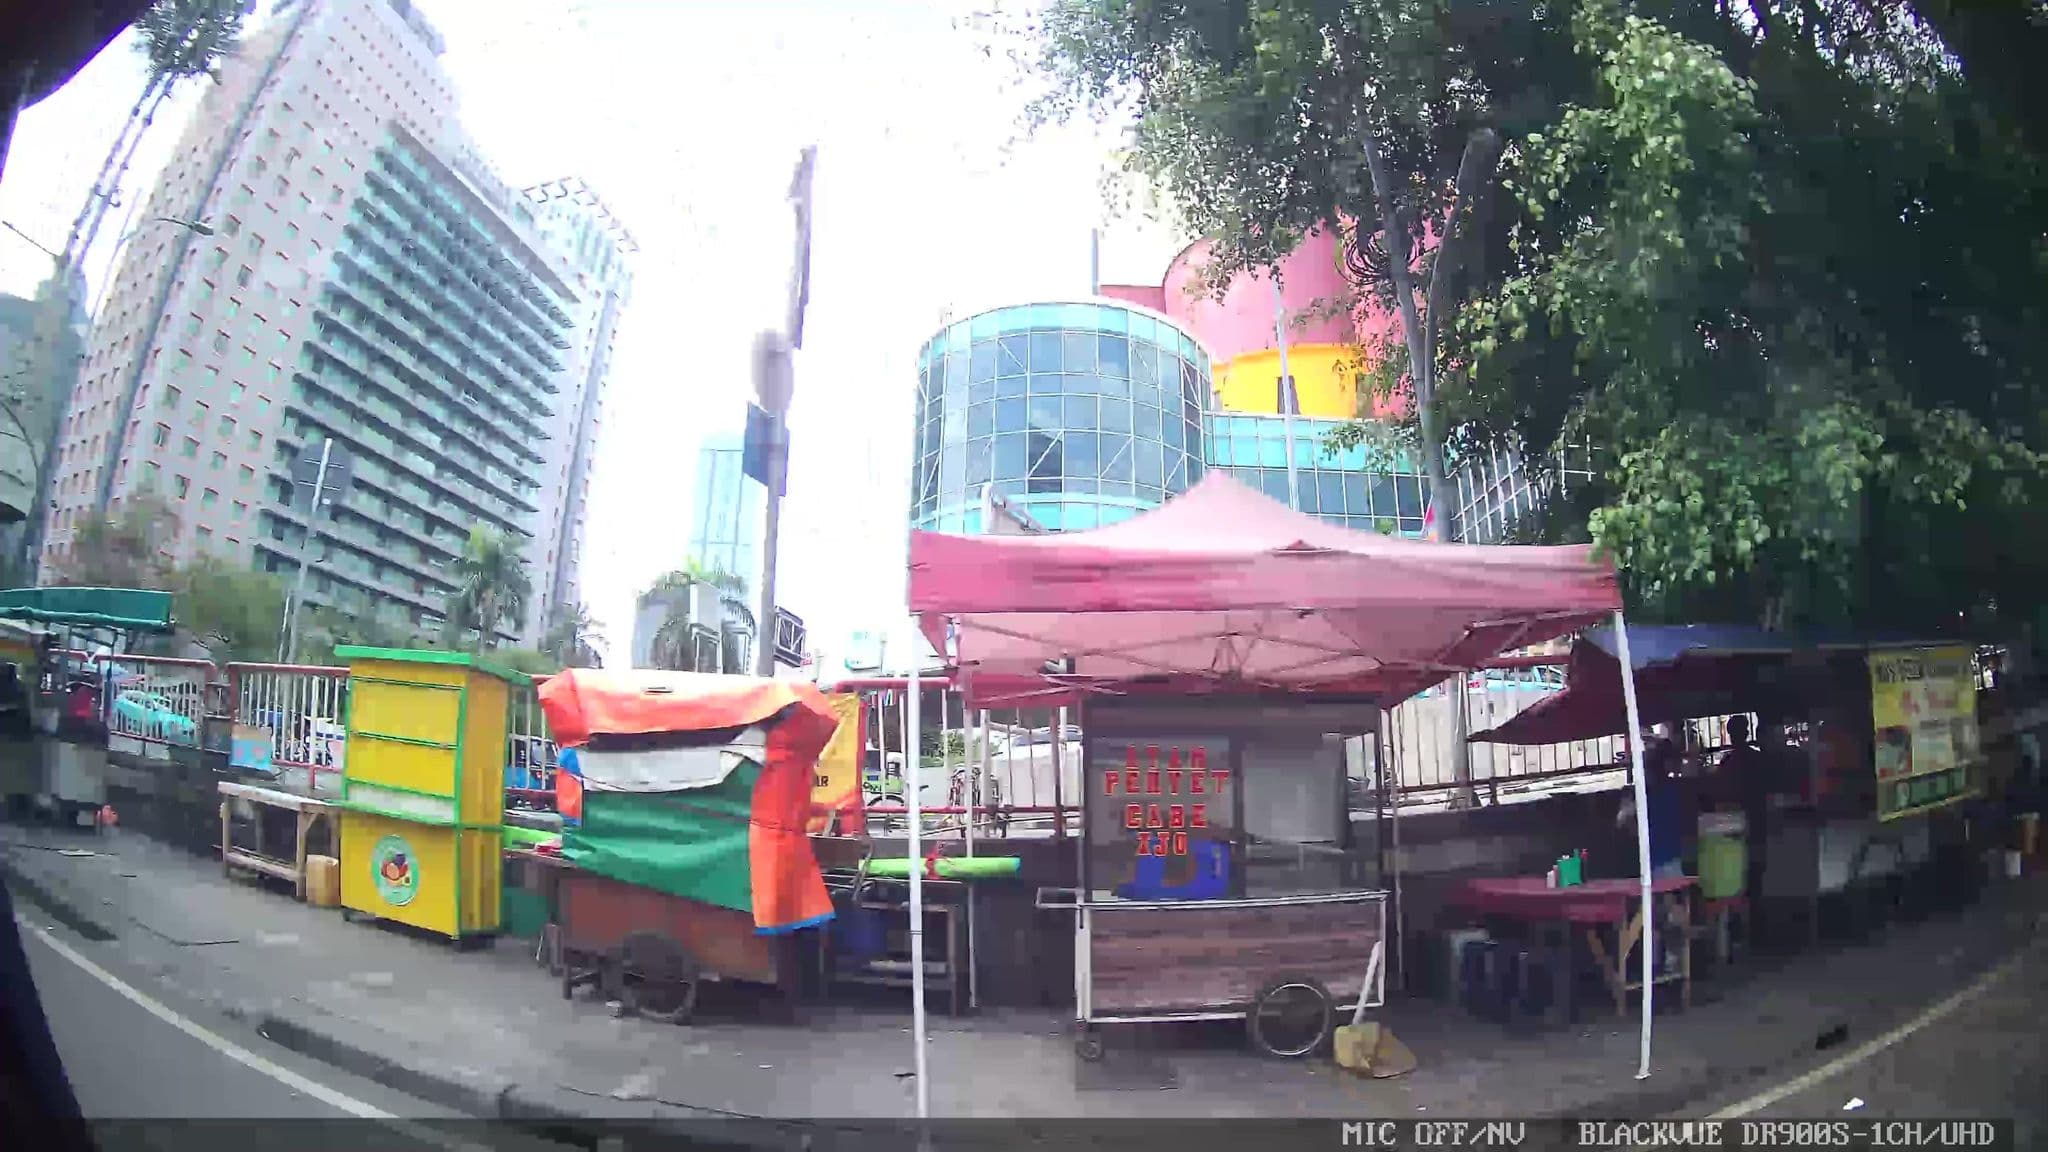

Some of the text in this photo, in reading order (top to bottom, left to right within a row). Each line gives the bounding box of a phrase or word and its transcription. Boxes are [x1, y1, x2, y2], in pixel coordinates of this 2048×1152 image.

[1125, 745, 1207, 769] AYAM
[1104, 770, 1230, 795] PENYET
[1126, 803, 1207, 828] CABE
